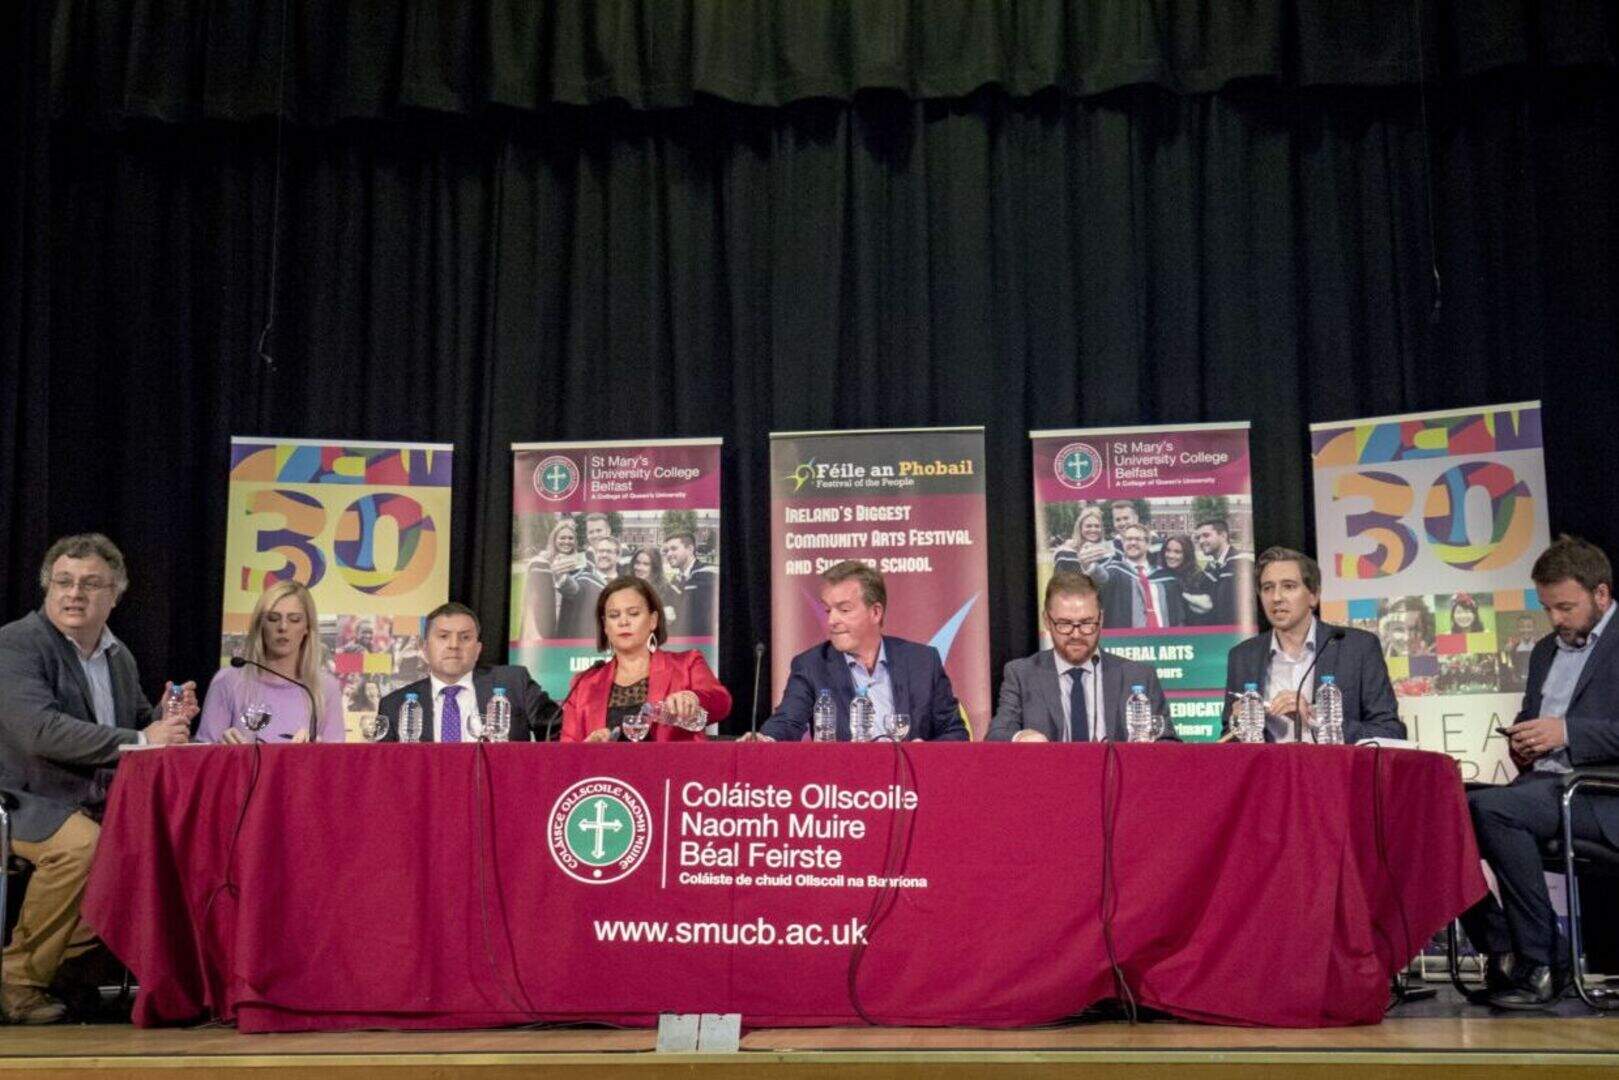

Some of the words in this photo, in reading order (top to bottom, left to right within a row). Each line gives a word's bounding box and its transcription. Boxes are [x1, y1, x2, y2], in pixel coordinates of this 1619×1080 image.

[1114, 442, 1128, 454] St
[1131, 440, 1174, 454] Mary's
[591, 456, 605, 468] St
[608, 455, 649, 468] Mary's
[1114, 454, 1176, 467] University
[1179, 451, 1228, 465] College
[591, 468, 650, 481] University
[653, 466, 700, 480] College
[815, 463, 866, 479] Féile
[870, 465, 894, 477] an
[899, 460, 974, 476] Phobail
[1115, 467, 1159, 479] Belfast
[591, 481, 633, 492] Belfast
[816, 478, 852, 488] Festival
[854, 478, 864, 487] of
[865, 478, 880, 487] the
[881, 477, 915, 488] People
[1332, 461, 1536, 579] 30
[241, 489, 437, 597] 30
[1159, 645, 1194, 660] ARTS
[682, 781, 793, 808] Coláiste
[800, 783, 919, 810] Ollscoile
[622, 792, 646, 833] NAOMH
[681, 811, 779, 838] Naomh
[788, 813, 866, 839] Muire
[618, 835, 646, 870] MUIRE
[680, 840, 740, 867] Béal
[748, 842, 842, 869] Feirste
[679, 871, 734, 886] Coláiste
[735, 872, 752, 886] de
[755, 873, 792, 887] chuid
[795, 873, 847, 888] Ollscoil
[848, 876, 864, 887] na
[593, 917, 869, 945] www.smucb.ac.uk
